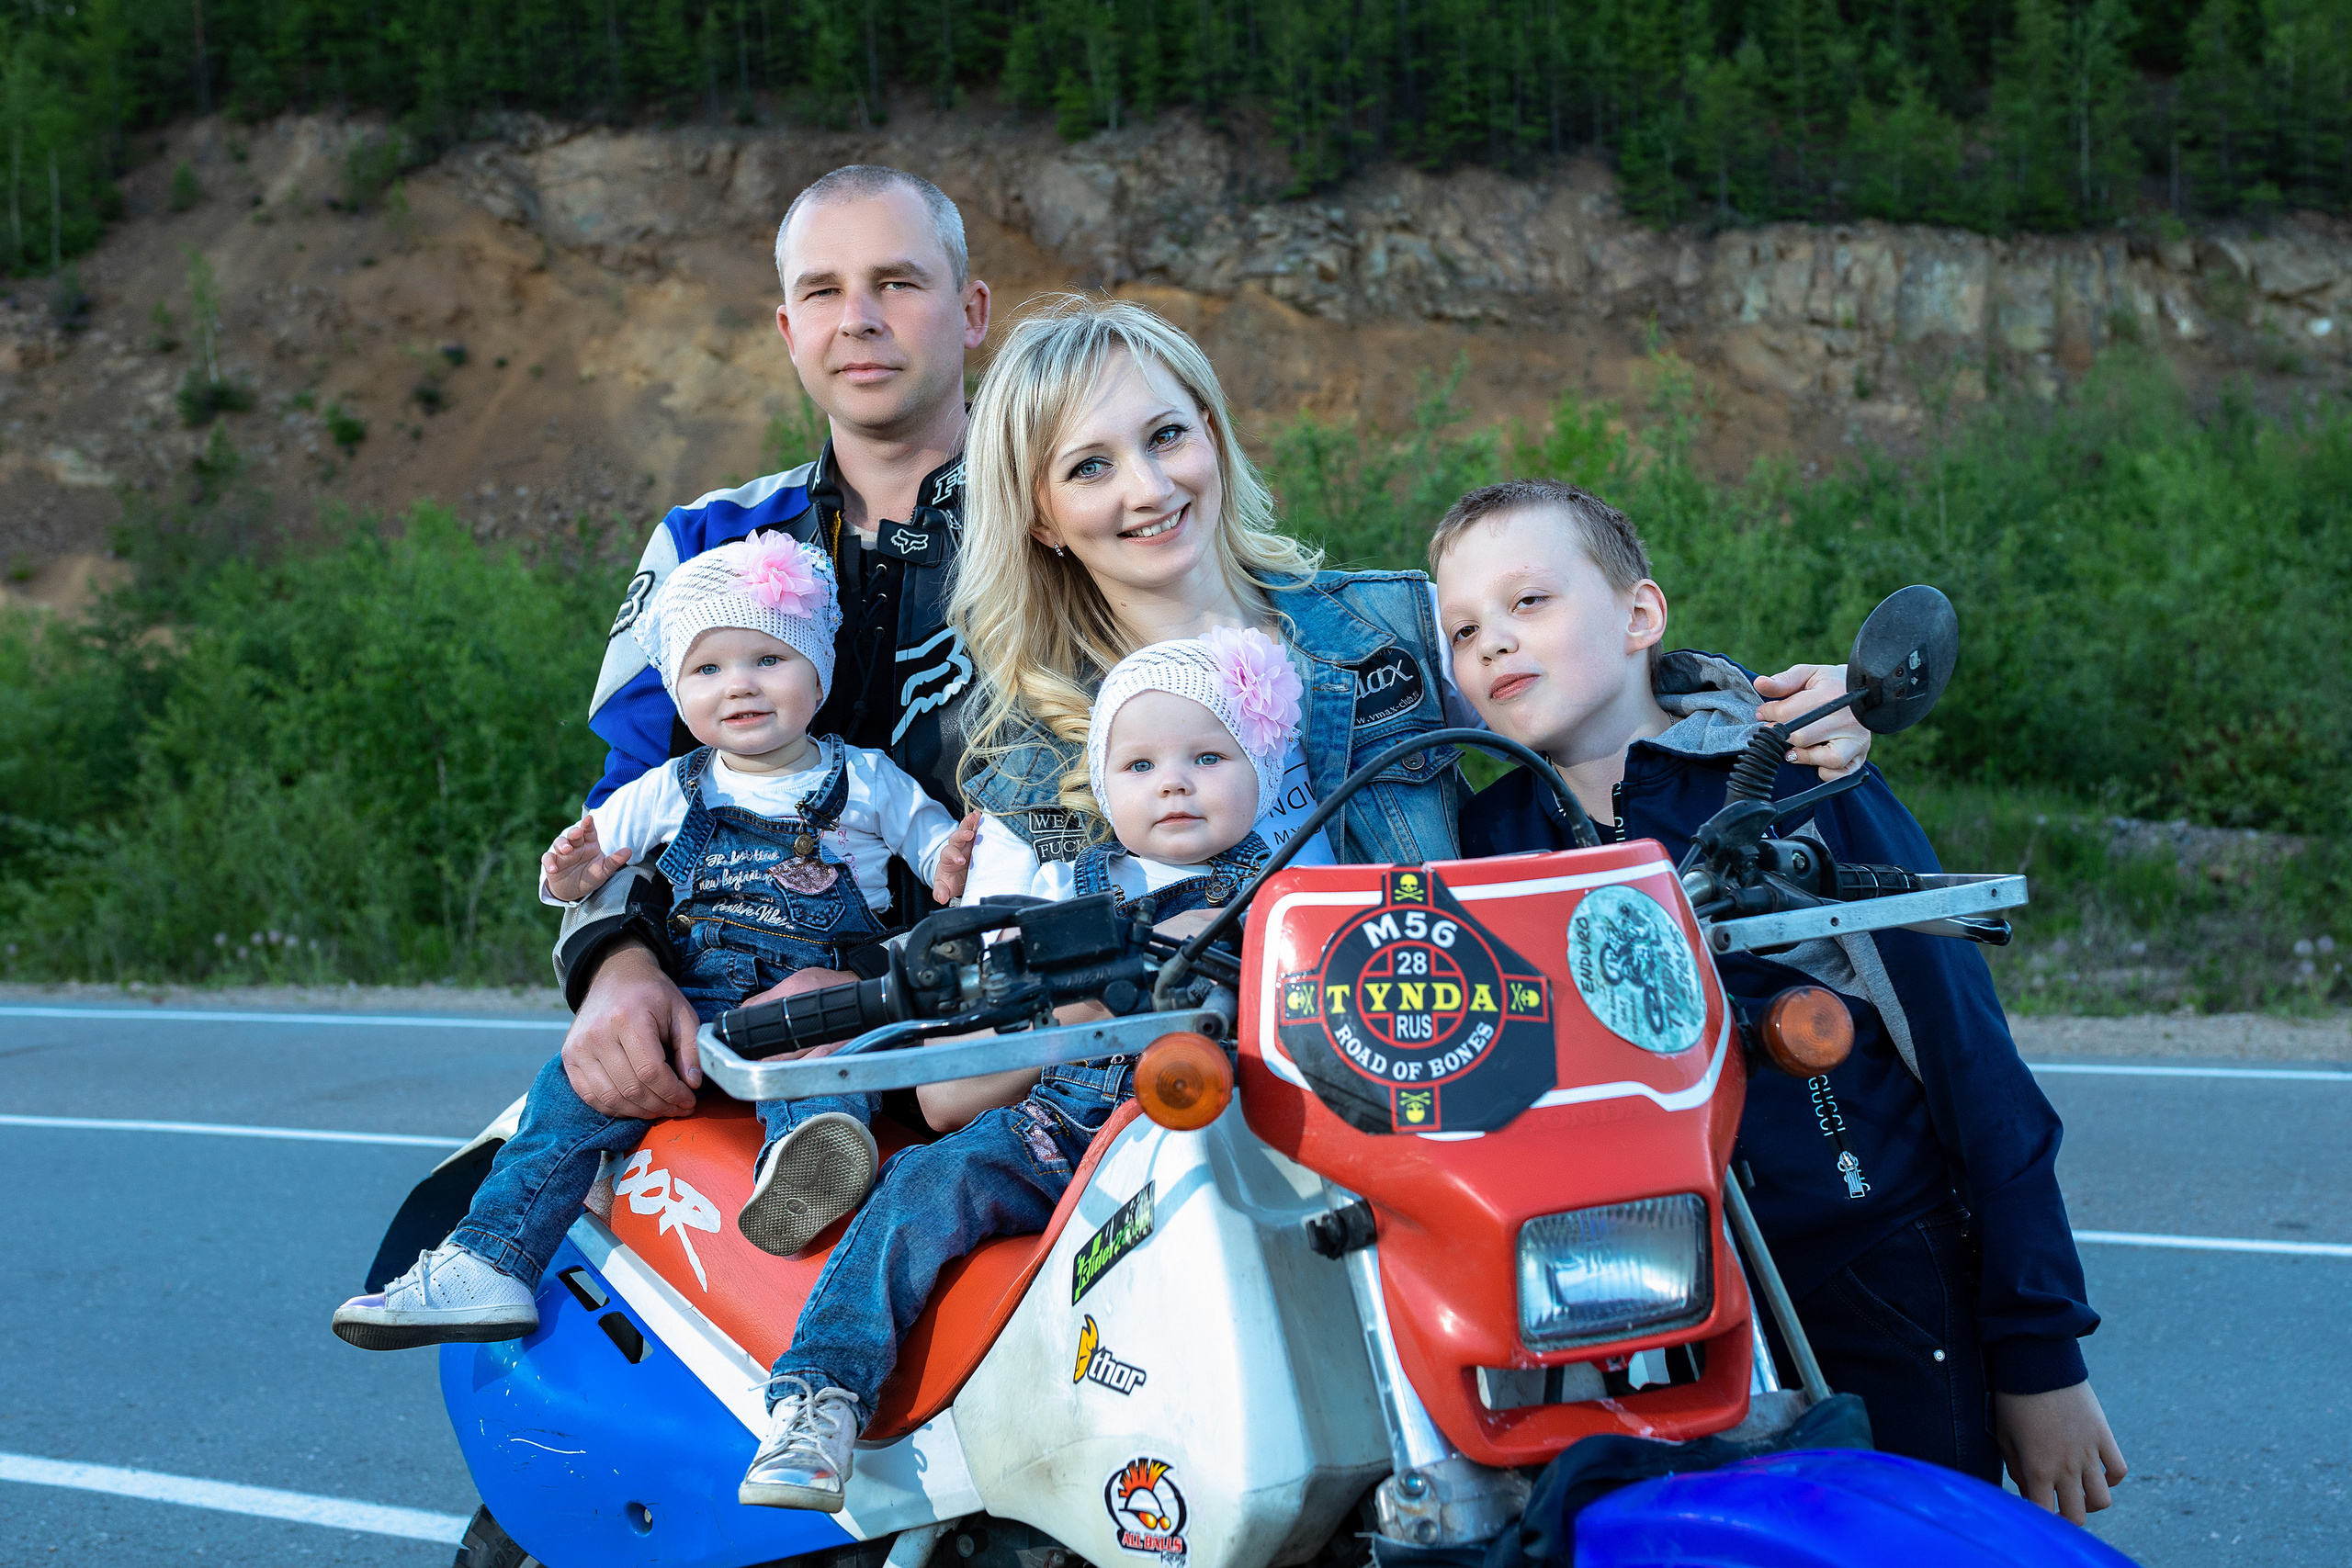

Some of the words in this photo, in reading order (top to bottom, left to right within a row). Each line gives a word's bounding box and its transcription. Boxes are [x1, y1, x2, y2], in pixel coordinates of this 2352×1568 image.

[1362, 911, 1458, 949] M56
[1396, 952, 1429, 976] 28
[1576, 916, 1596, 994] ENDURO
[1326, 982, 1499, 1015] TYNDA
[1396, 1014, 1433, 1040] RUS
[1334, 1022, 1388, 1075] ROAD
[1392, 1060, 1423, 1080] OF
[1427, 1021, 1496, 1079] BONES
[1808, 1074, 1846, 1136] GUCCI
[1088, 1348, 1147, 1394] thor
[1122, 1530, 1143, 1549] ALL
[1144, 1534, 1182, 1553] BALLS
